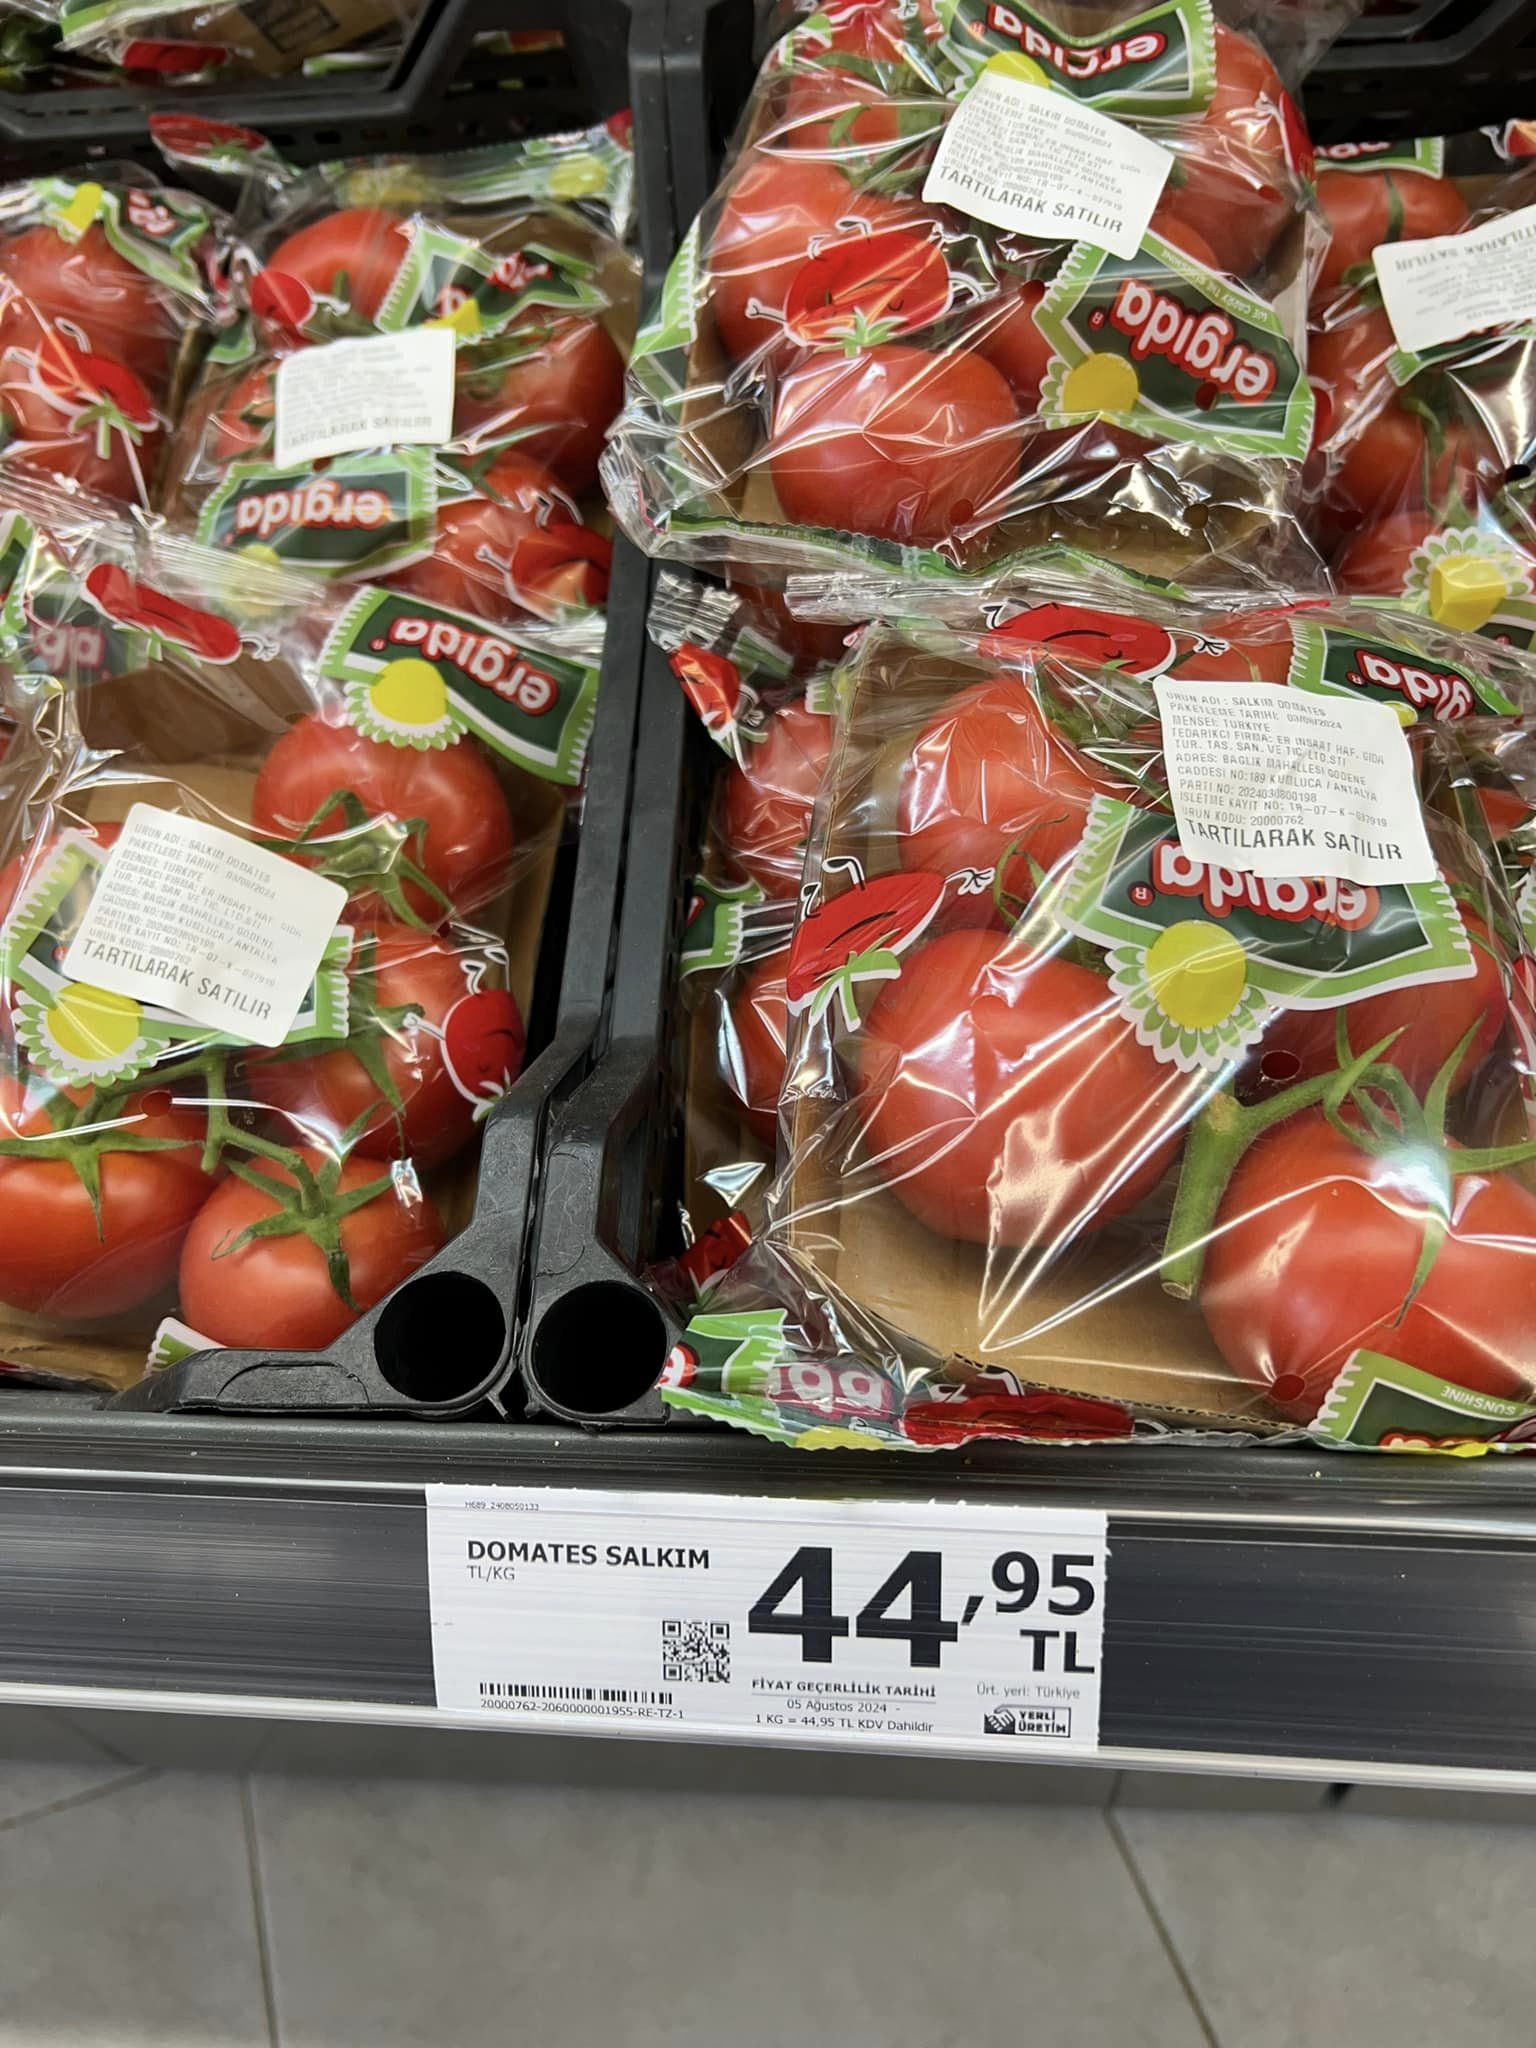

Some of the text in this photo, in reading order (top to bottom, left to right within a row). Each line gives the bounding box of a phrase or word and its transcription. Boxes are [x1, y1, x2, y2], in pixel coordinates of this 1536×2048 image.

[938, 165, 1047, 215] TARTILARAK
[1052, 201, 1124, 234] SATILIR
[1178, 767, 1226, 778] CADDESI
[1184, 818, 1403, 859] TARTILARAK SATILIR
[83, 938, 272, 1018] TARTILARAK SATILIR
[1440, 1385, 1517, 1417] SUNSHINE
[467, 1540, 710, 1570] DOMATES SALKIM
[466, 1565, 516, 1583] TL/KG
[1019, 1629, 1096, 1674] TL
[752, 1677, 937, 1698] FİYAT GEÇERLİLİK TARİHİ
[977, 1681, 1081, 1701] Ürt. yeri: Türkiye
[787, 1700, 802, 1710] 05
[806, 1700, 854, 1713] Ağustos
[858, 1702, 887, 1713] 2024
[766, 1714, 784, 1725] KG
[801, 1716, 835, 1728] 44,95
[840, 1718, 854, 1729] TL
[858, 1719, 884, 1730] KDV
[887, 1719, 935, 1733] Dahildir
